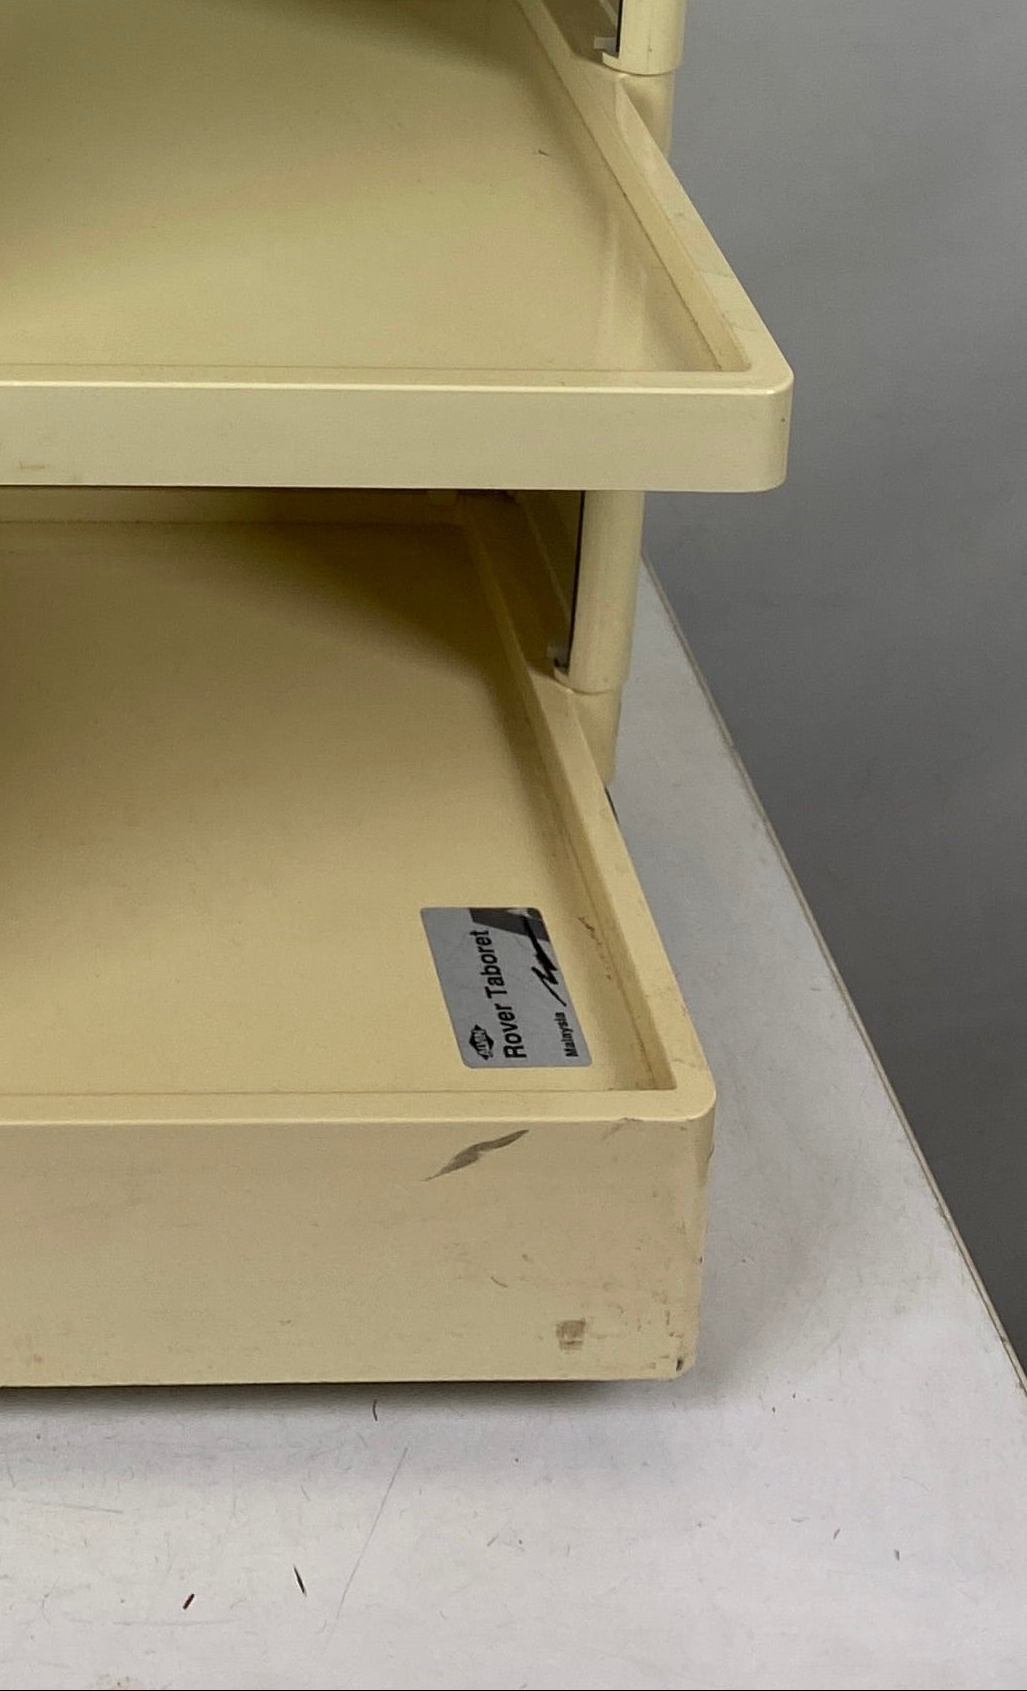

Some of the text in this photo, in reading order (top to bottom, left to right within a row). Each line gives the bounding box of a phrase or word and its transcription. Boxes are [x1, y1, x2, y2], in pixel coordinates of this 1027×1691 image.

[470, 929, 527, 1058] Rover Taboret
[554, 1012, 579, 1057] Malaysia
